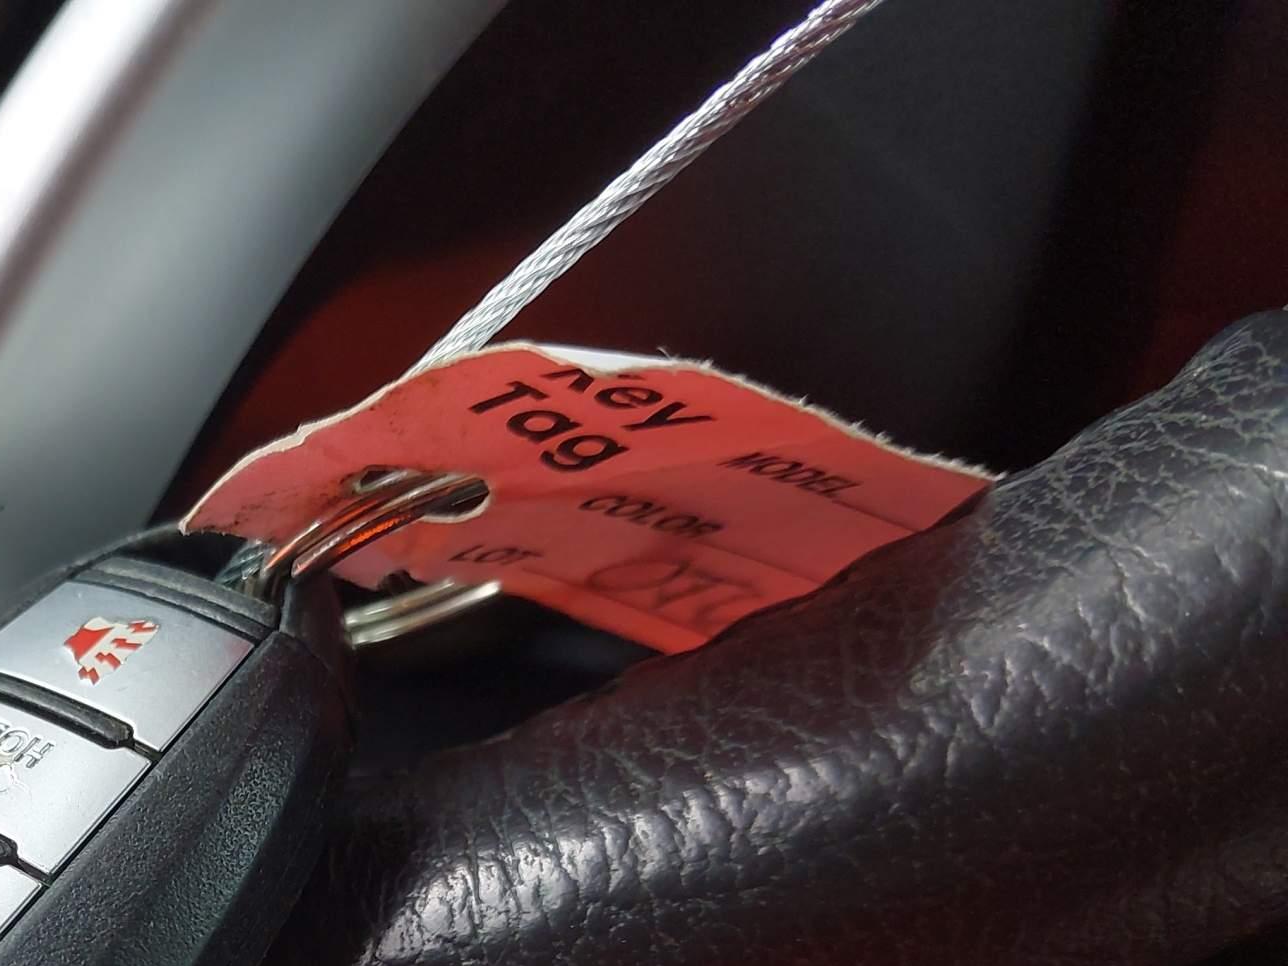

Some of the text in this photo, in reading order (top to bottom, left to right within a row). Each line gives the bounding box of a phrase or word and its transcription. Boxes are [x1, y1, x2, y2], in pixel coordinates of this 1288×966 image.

[468, 380, 630, 472] Tag
[716, 452, 864, 497] MODEL
[578, 495, 725, 537] COLOR
[448, 544, 545, 566] LOT
